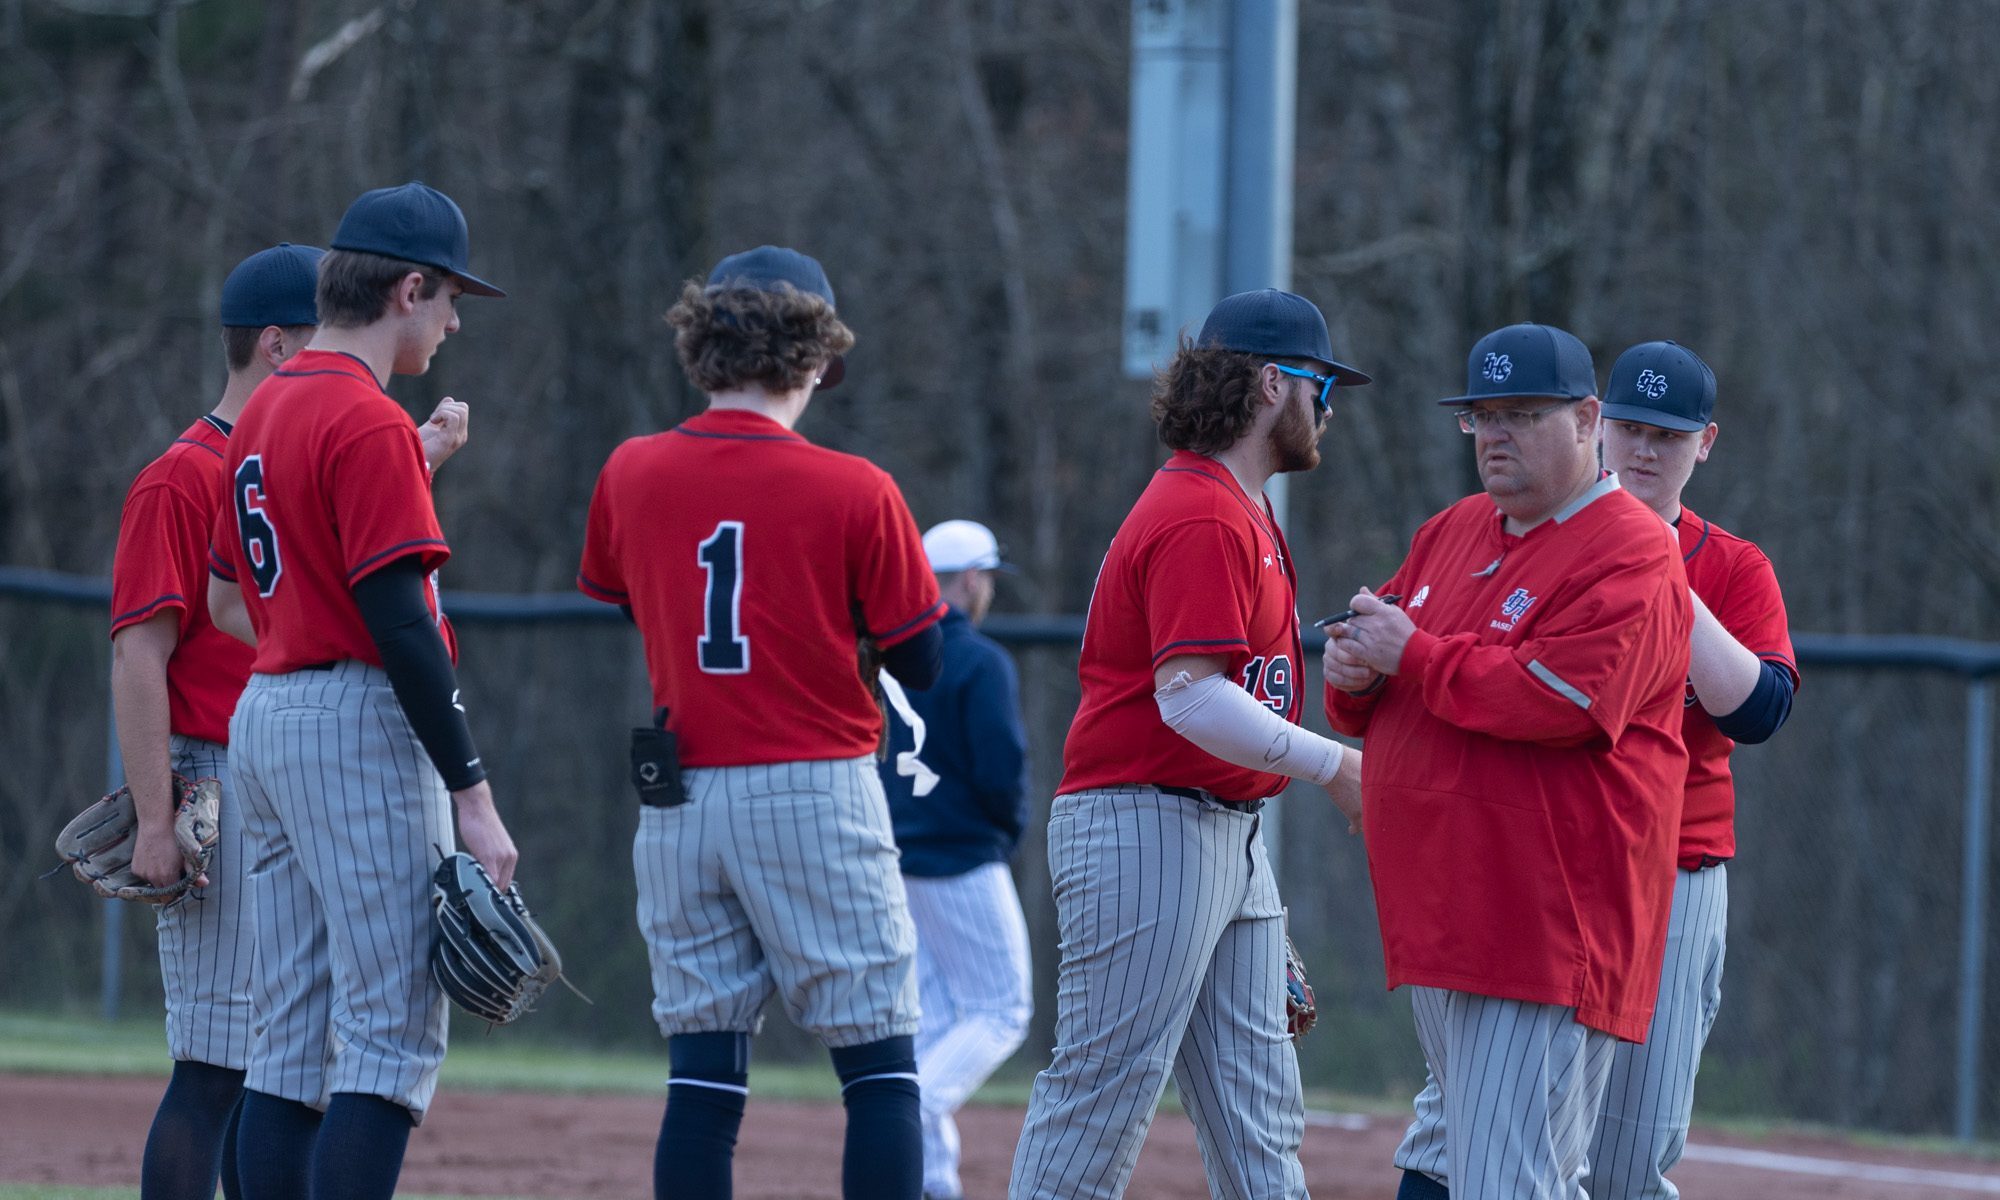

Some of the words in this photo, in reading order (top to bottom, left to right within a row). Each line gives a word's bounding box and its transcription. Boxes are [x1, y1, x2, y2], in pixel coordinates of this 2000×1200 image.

[234, 454, 283, 598] 6
[697, 520, 750, 674] 1
[1242, 654, 1293, 720] 19
